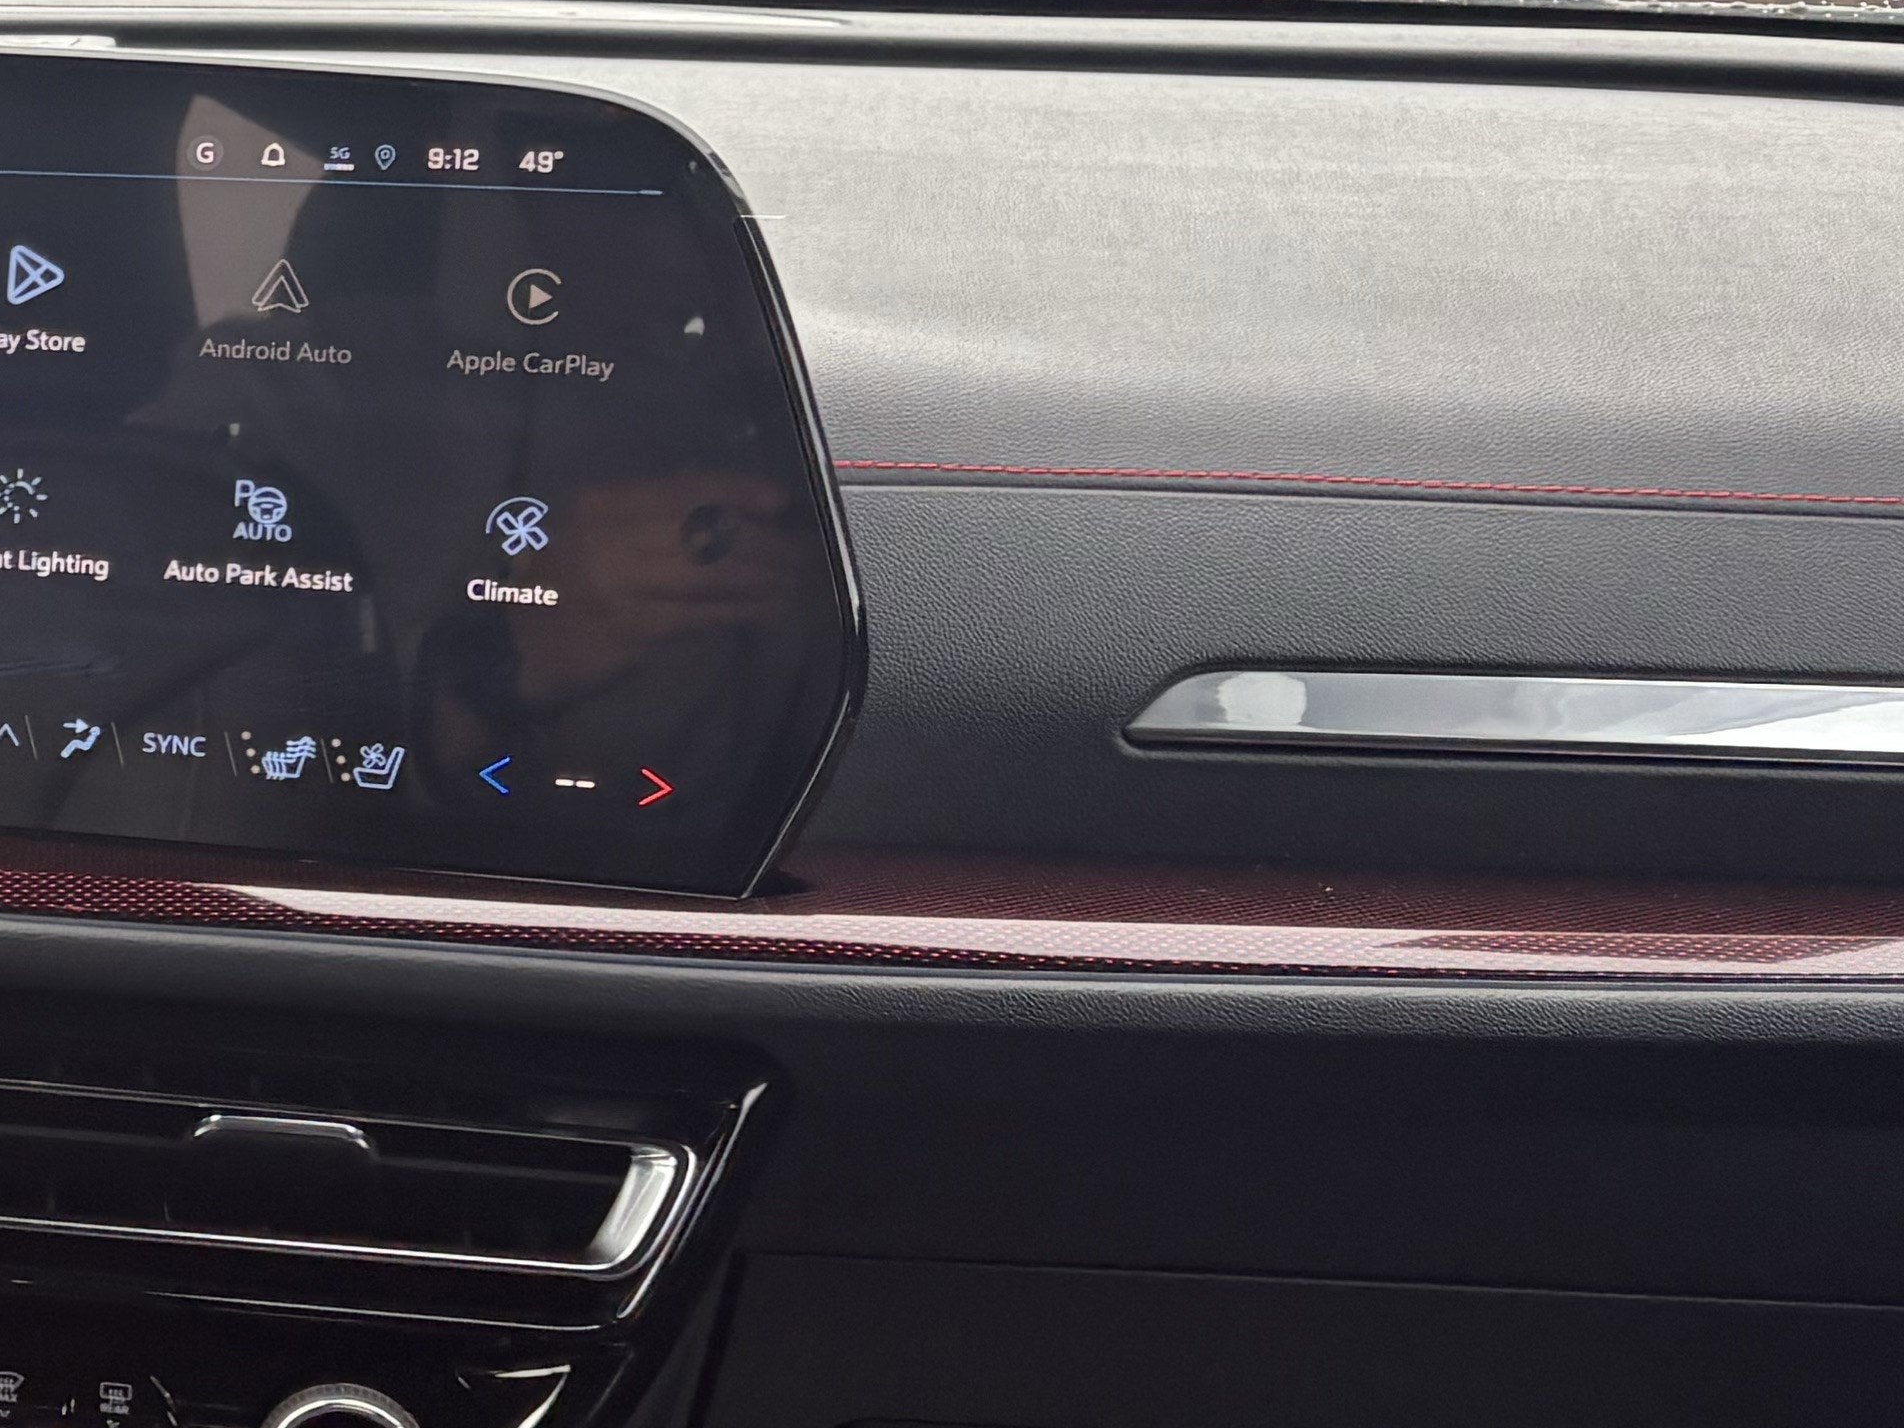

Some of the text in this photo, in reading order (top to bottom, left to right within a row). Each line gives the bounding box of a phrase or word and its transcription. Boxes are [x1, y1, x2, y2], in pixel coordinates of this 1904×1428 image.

[197, 143, 213, 163] G
[331, 147, 350, 159] 5G
[428, 148, 479, 170] 9:12
[520, 152, 563, 172] 49°
[26, 330, 85, 351] Store
[200, 339, 351, 363] Android Auto
[447, 350, 614, 381] Apple CarPlay
[232, 521, 292, 543] AUTO
[19, 551, 108, 580] Lighting
[164, 560, 352, 591] Auto Park Assist
[468, 579, 558, 605] Climate
[143, 733, 205, 756] SYNC
